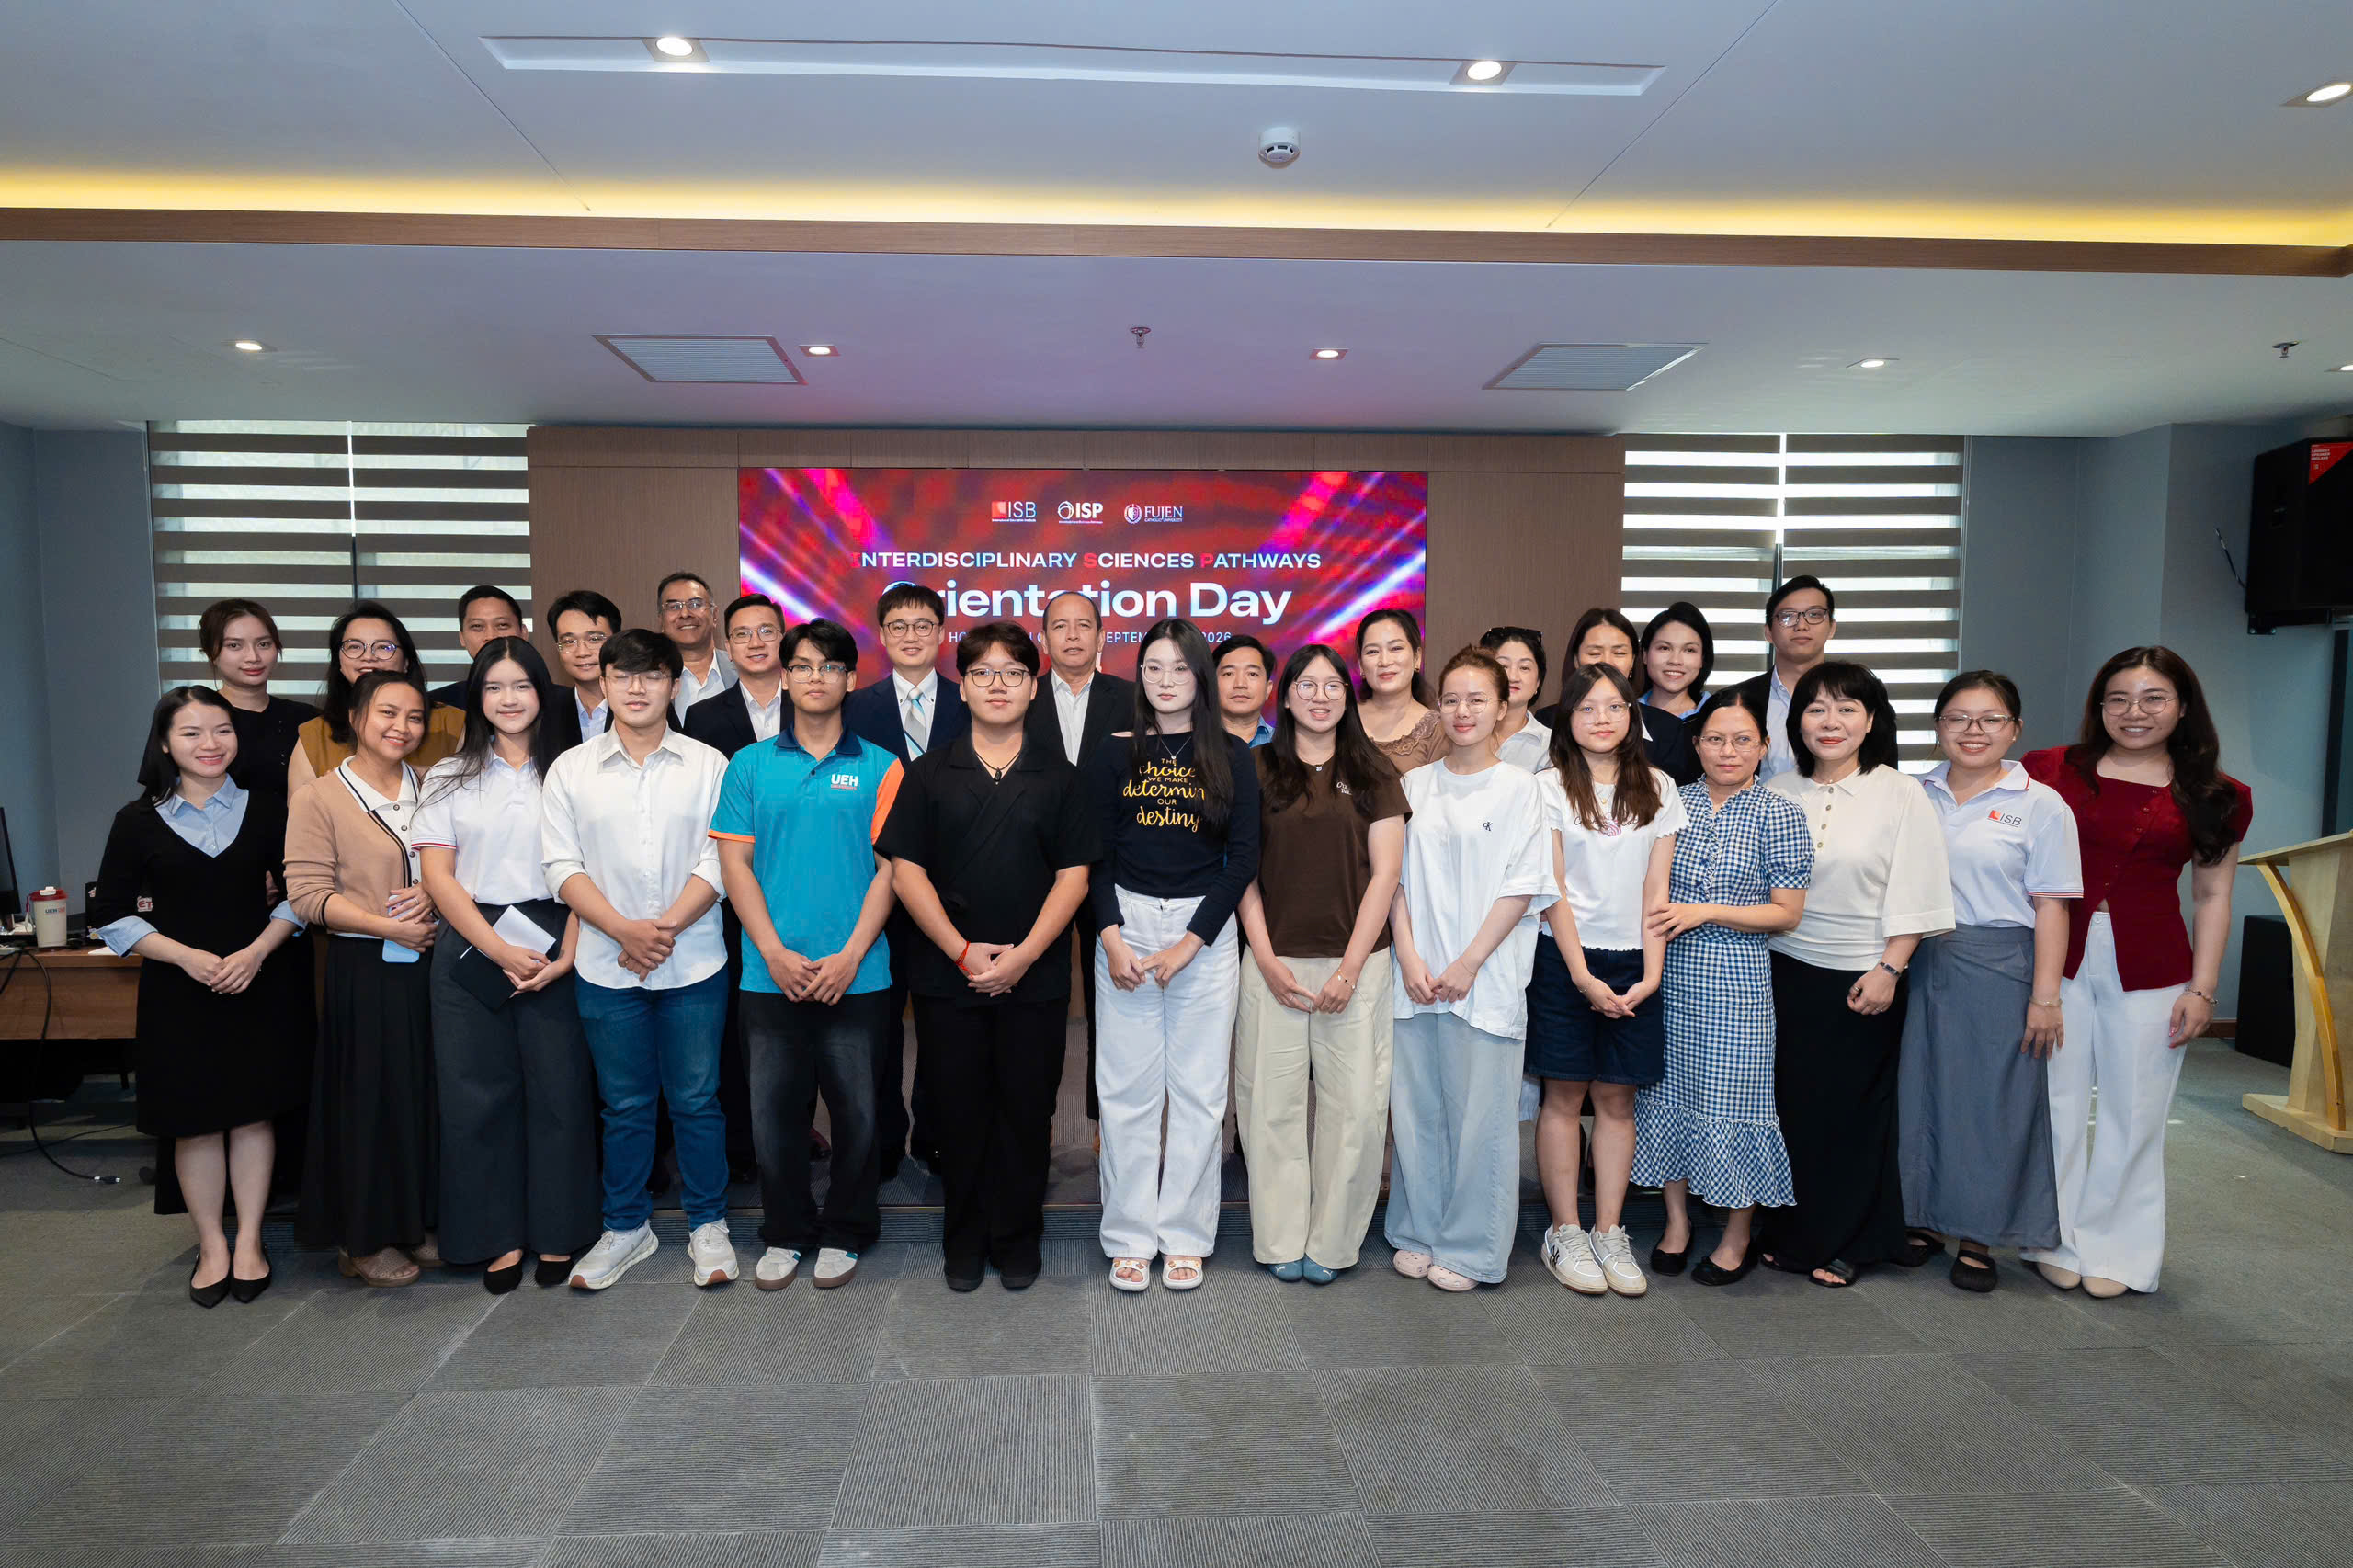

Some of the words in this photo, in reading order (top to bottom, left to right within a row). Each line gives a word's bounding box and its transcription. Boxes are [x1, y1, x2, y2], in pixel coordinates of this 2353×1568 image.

[1008, 501, 1037, 518] ISB
[1076, 502, 1103, 518] ISP
[1144, 506, 1183, 520] FUJEN
[851, 551, 1078, 568] INTERDISCIPLINARY
[1083, 552, 1195, 569] SCIENCES
[1200, 553, 1322, 569] PATHWAYS
[1190, 582, 1292, 625] Day
[831, 773, 859, 787] UEH
[1136, 805, 1200, 833] destiny
[1999, 813, 2022, 825] ISB
